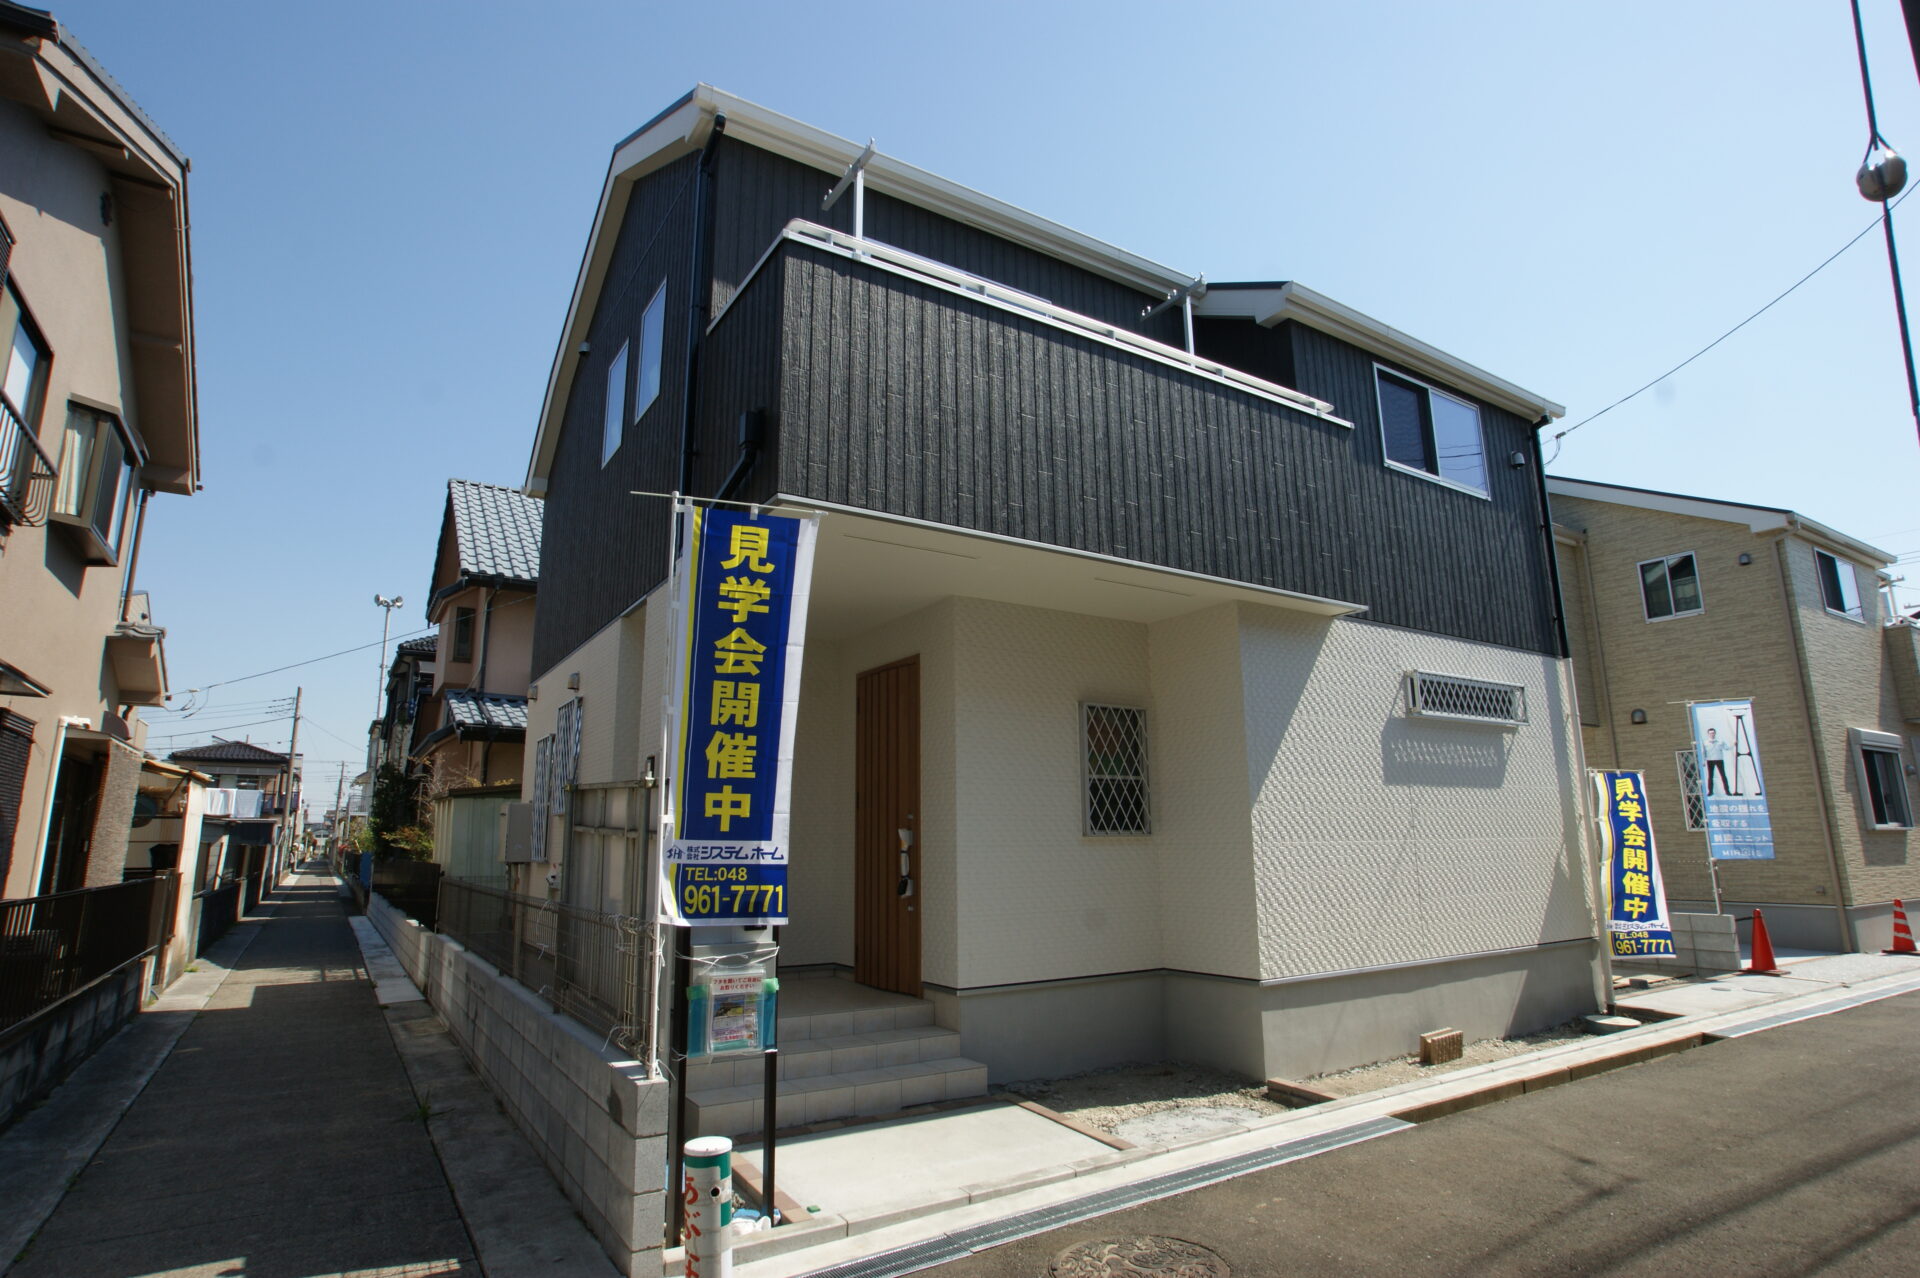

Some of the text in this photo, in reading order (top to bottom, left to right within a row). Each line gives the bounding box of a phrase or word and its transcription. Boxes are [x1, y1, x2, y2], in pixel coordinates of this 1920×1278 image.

[705, 525, 775, 833] 見学会開催中
[1615, 778, 1651, 919] 見学会開催中
[685, 867, 748, 881] TEL:048
[684, 885, 783, 914] 961-7771
[1615, 939, 1673, 954] 961-7771
